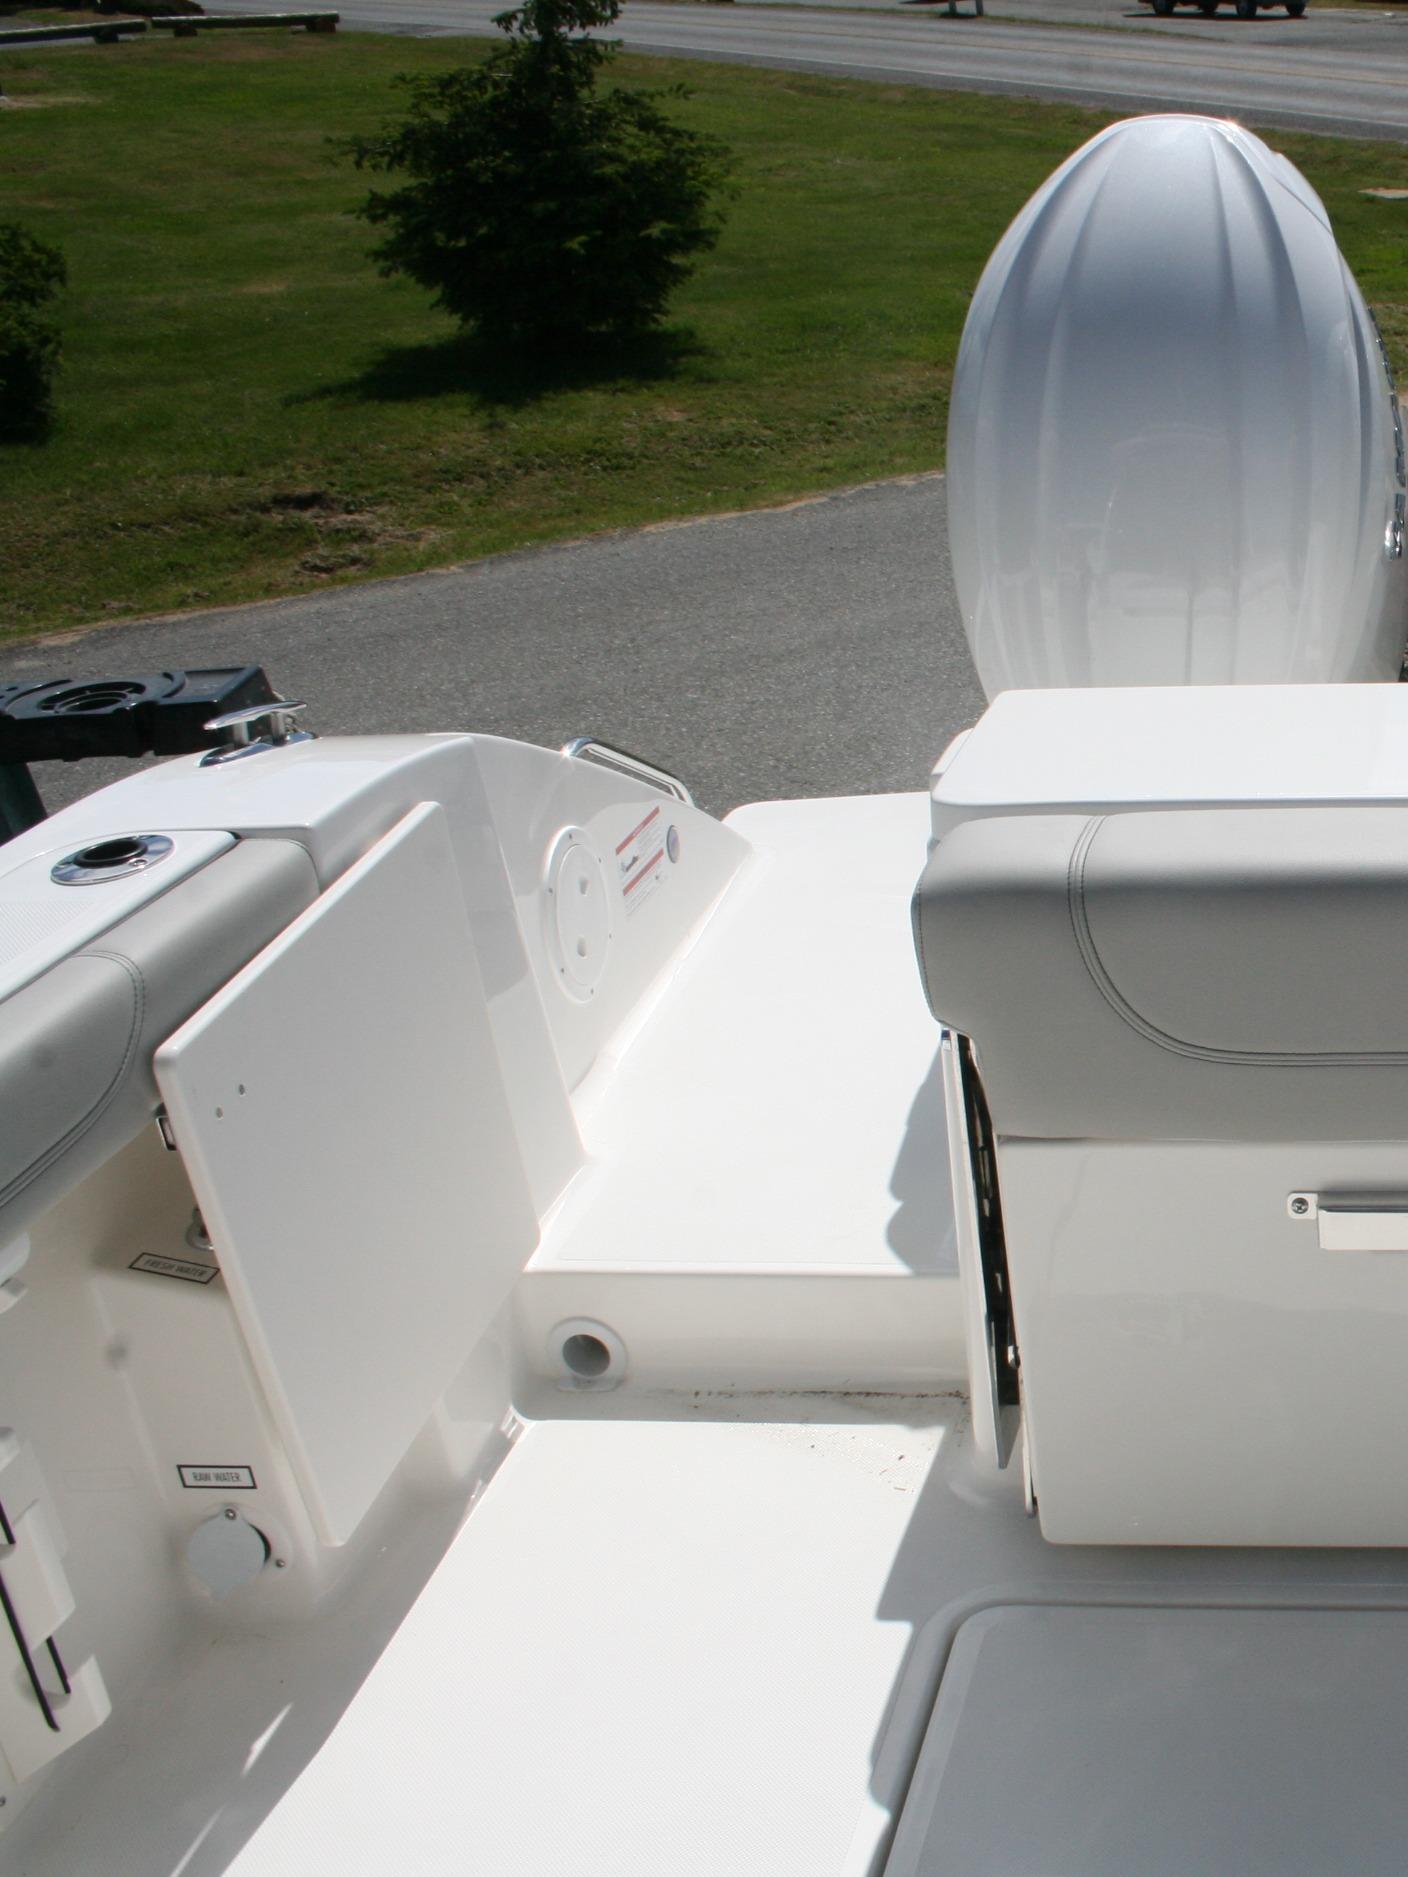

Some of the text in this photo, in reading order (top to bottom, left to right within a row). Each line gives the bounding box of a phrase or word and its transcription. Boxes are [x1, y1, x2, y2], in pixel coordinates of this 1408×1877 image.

[175, 1264, 208, 1278] WATER
[192, 1471, 241, 1483] RAW WATER
